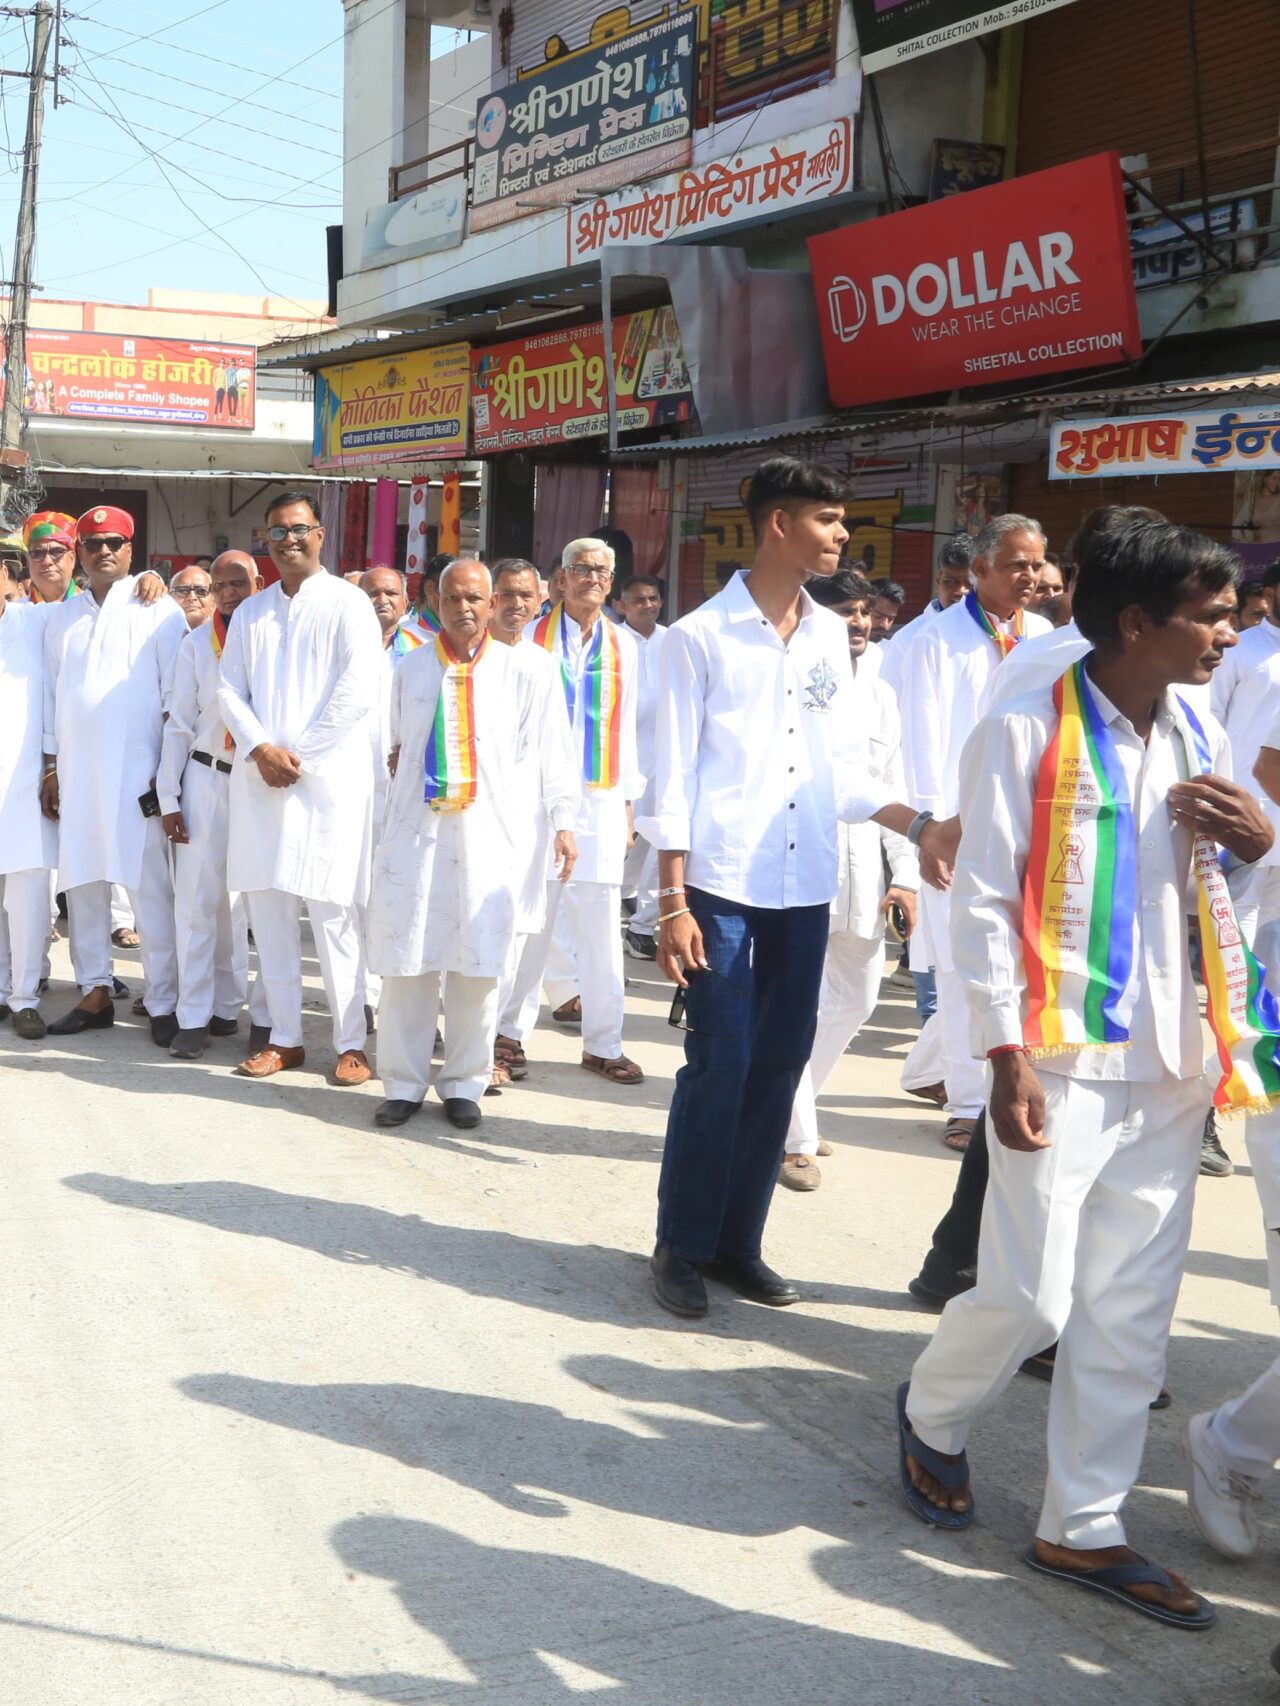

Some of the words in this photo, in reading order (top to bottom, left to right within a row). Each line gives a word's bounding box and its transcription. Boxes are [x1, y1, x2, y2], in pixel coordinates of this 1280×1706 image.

[896, 41, 924, 57] SHITAL
[926, 19, 979, 46] COLLECTION
[983, 10, 1010, 28] Mob.:
[598, 103, 646, 141] प्रेस
[534, 162, 549, 186] एवं
[553, 144, 599, 177] स्टेशनर्स
[758, 146, 807, 204] प्रेस
[871, 230, 1081, 326] DOLLAR
[912, 315, 961, 343] WEAR
[963, 310, 996, 333] THE
[1000, 291, 1082, 328] CHANGE
[31, 349, 138, 380] चन्द्रलोक
[141, 353, 215, 387] होजरी
[963, 346, 1025, 373] SHEETAL
[1027, 331, 1124, 362] COLLECTION
[58, 385, 68, 398] A
[70, 386, 125, 403] Complete
[127, 389, 165, 406] Family
[168, 392, 210, 408] Shopee
[341, 386, 405, 427] मोनिका
[408, 377, 465, 419] फैशन
[1056, 419, 1188, 476] सुभाष
